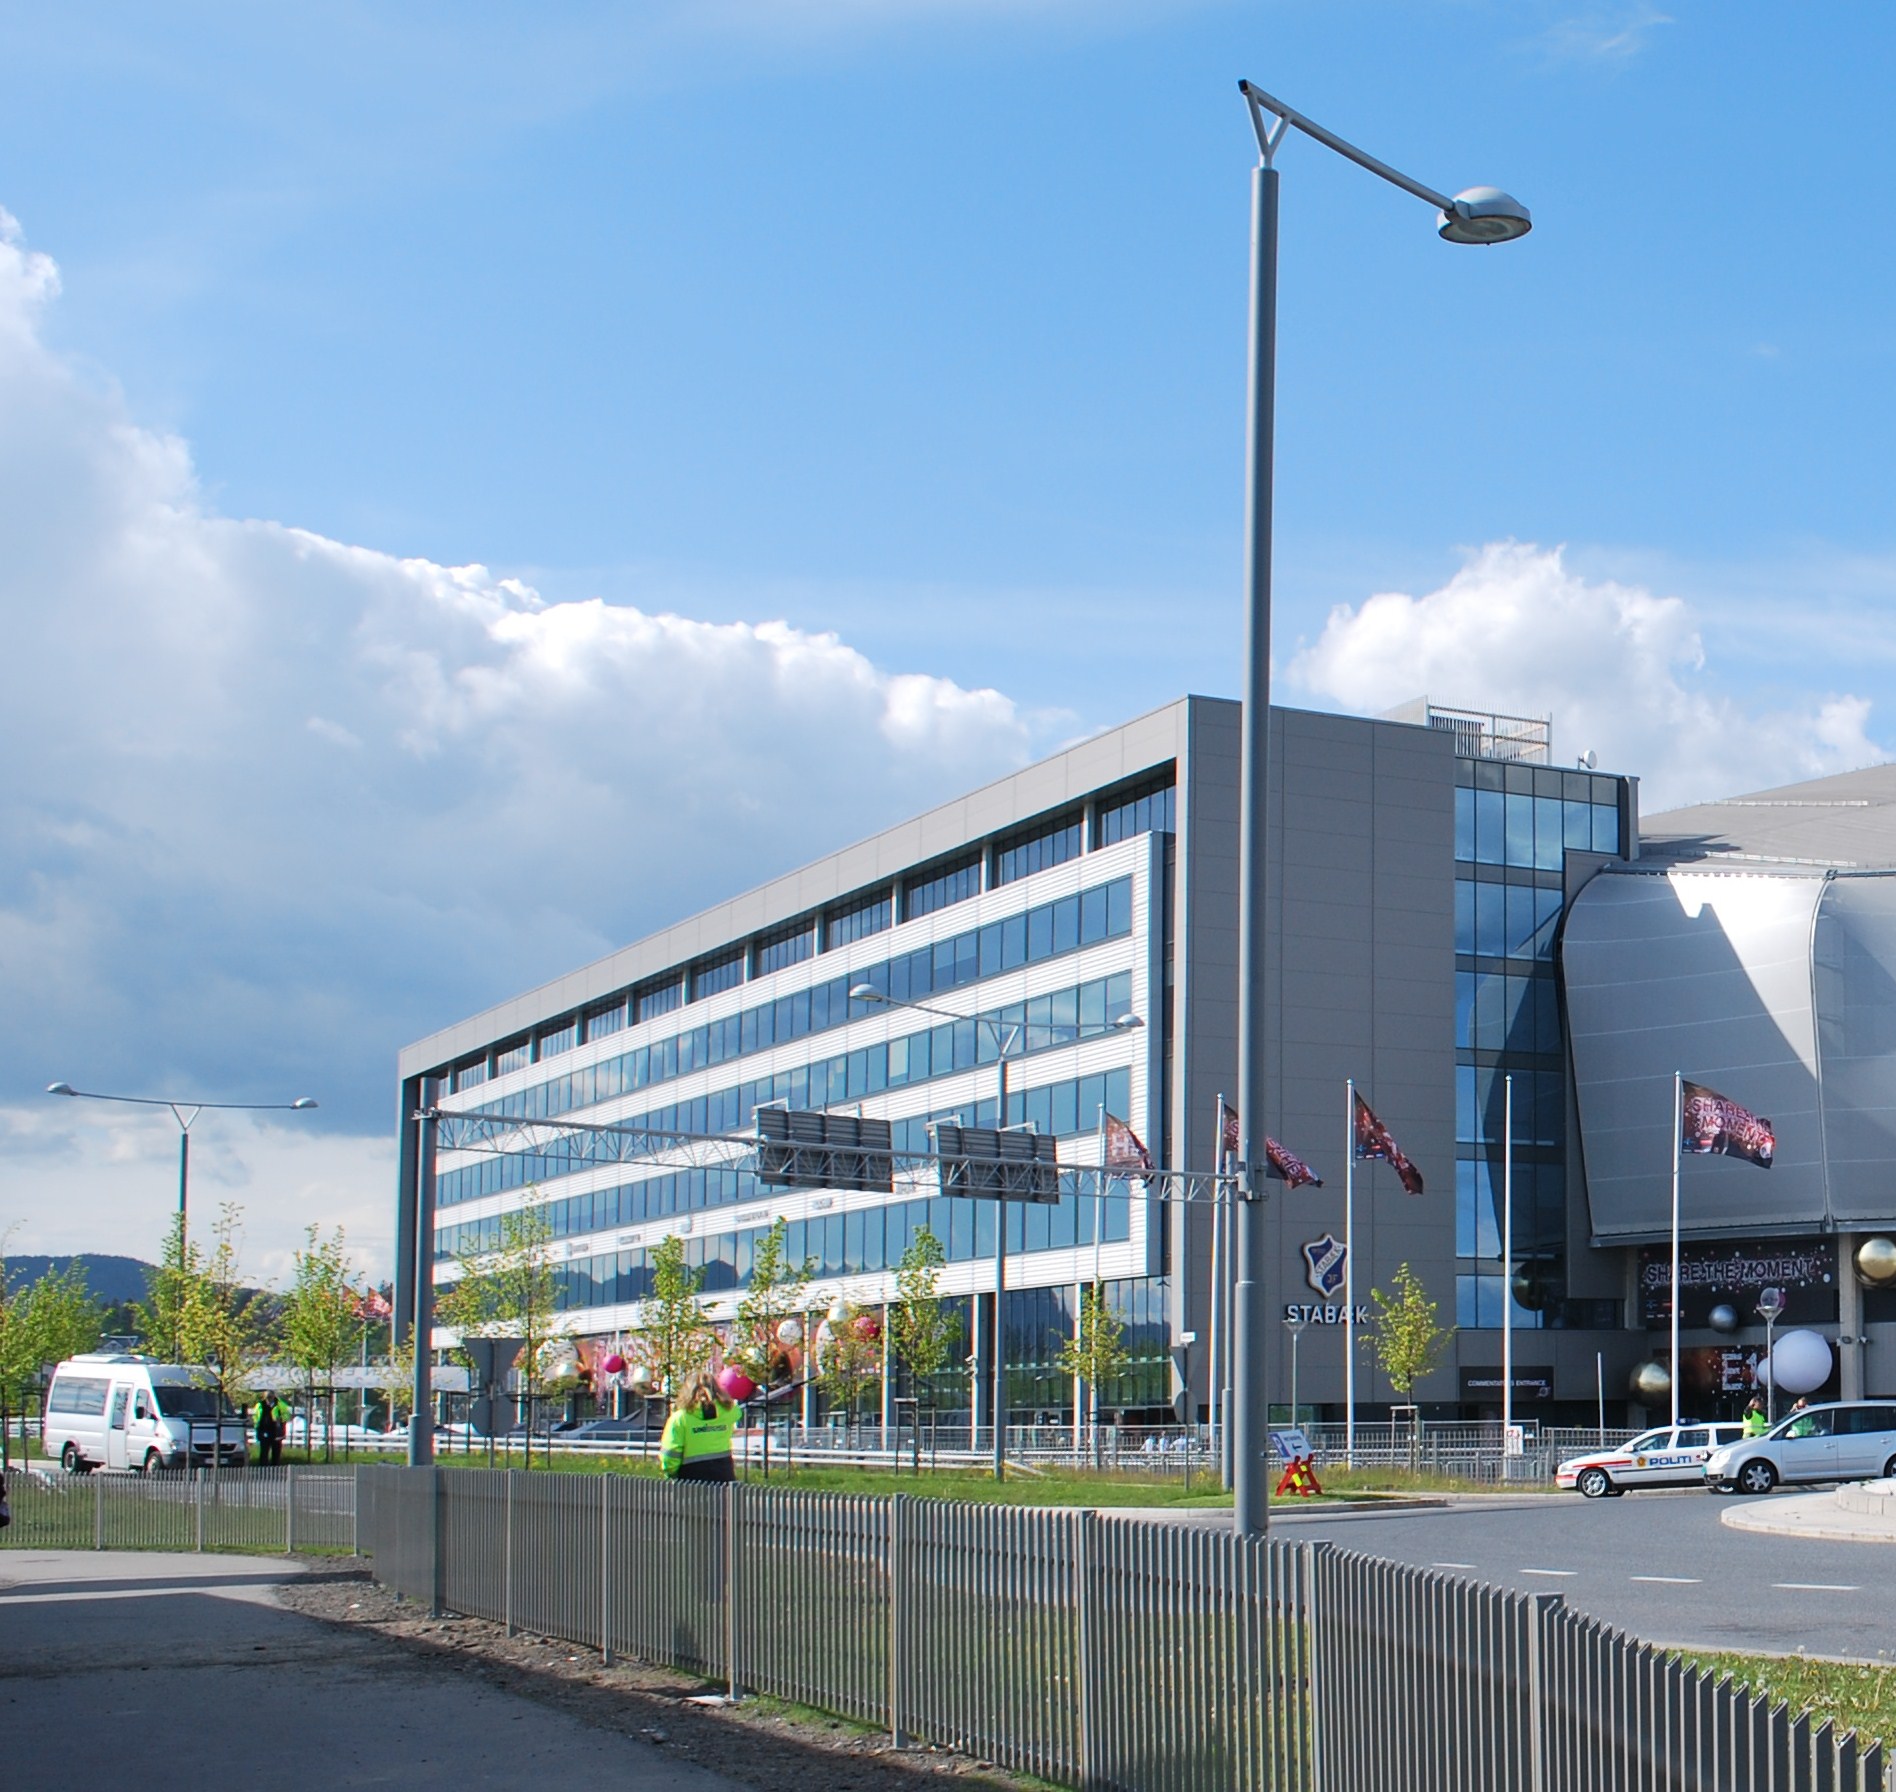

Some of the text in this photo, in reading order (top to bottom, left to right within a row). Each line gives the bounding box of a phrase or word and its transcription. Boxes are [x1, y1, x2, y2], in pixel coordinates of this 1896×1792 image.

[1692, 1097, 1747, 1118] SHARE
[1705, 1261, 1736, 1282] THE
[1740, 1258, 1814, 1280] MOMENT
[1721, 1352, 1758, 1391] E1
[1649, 1455, 1692, 1466] POLITI
